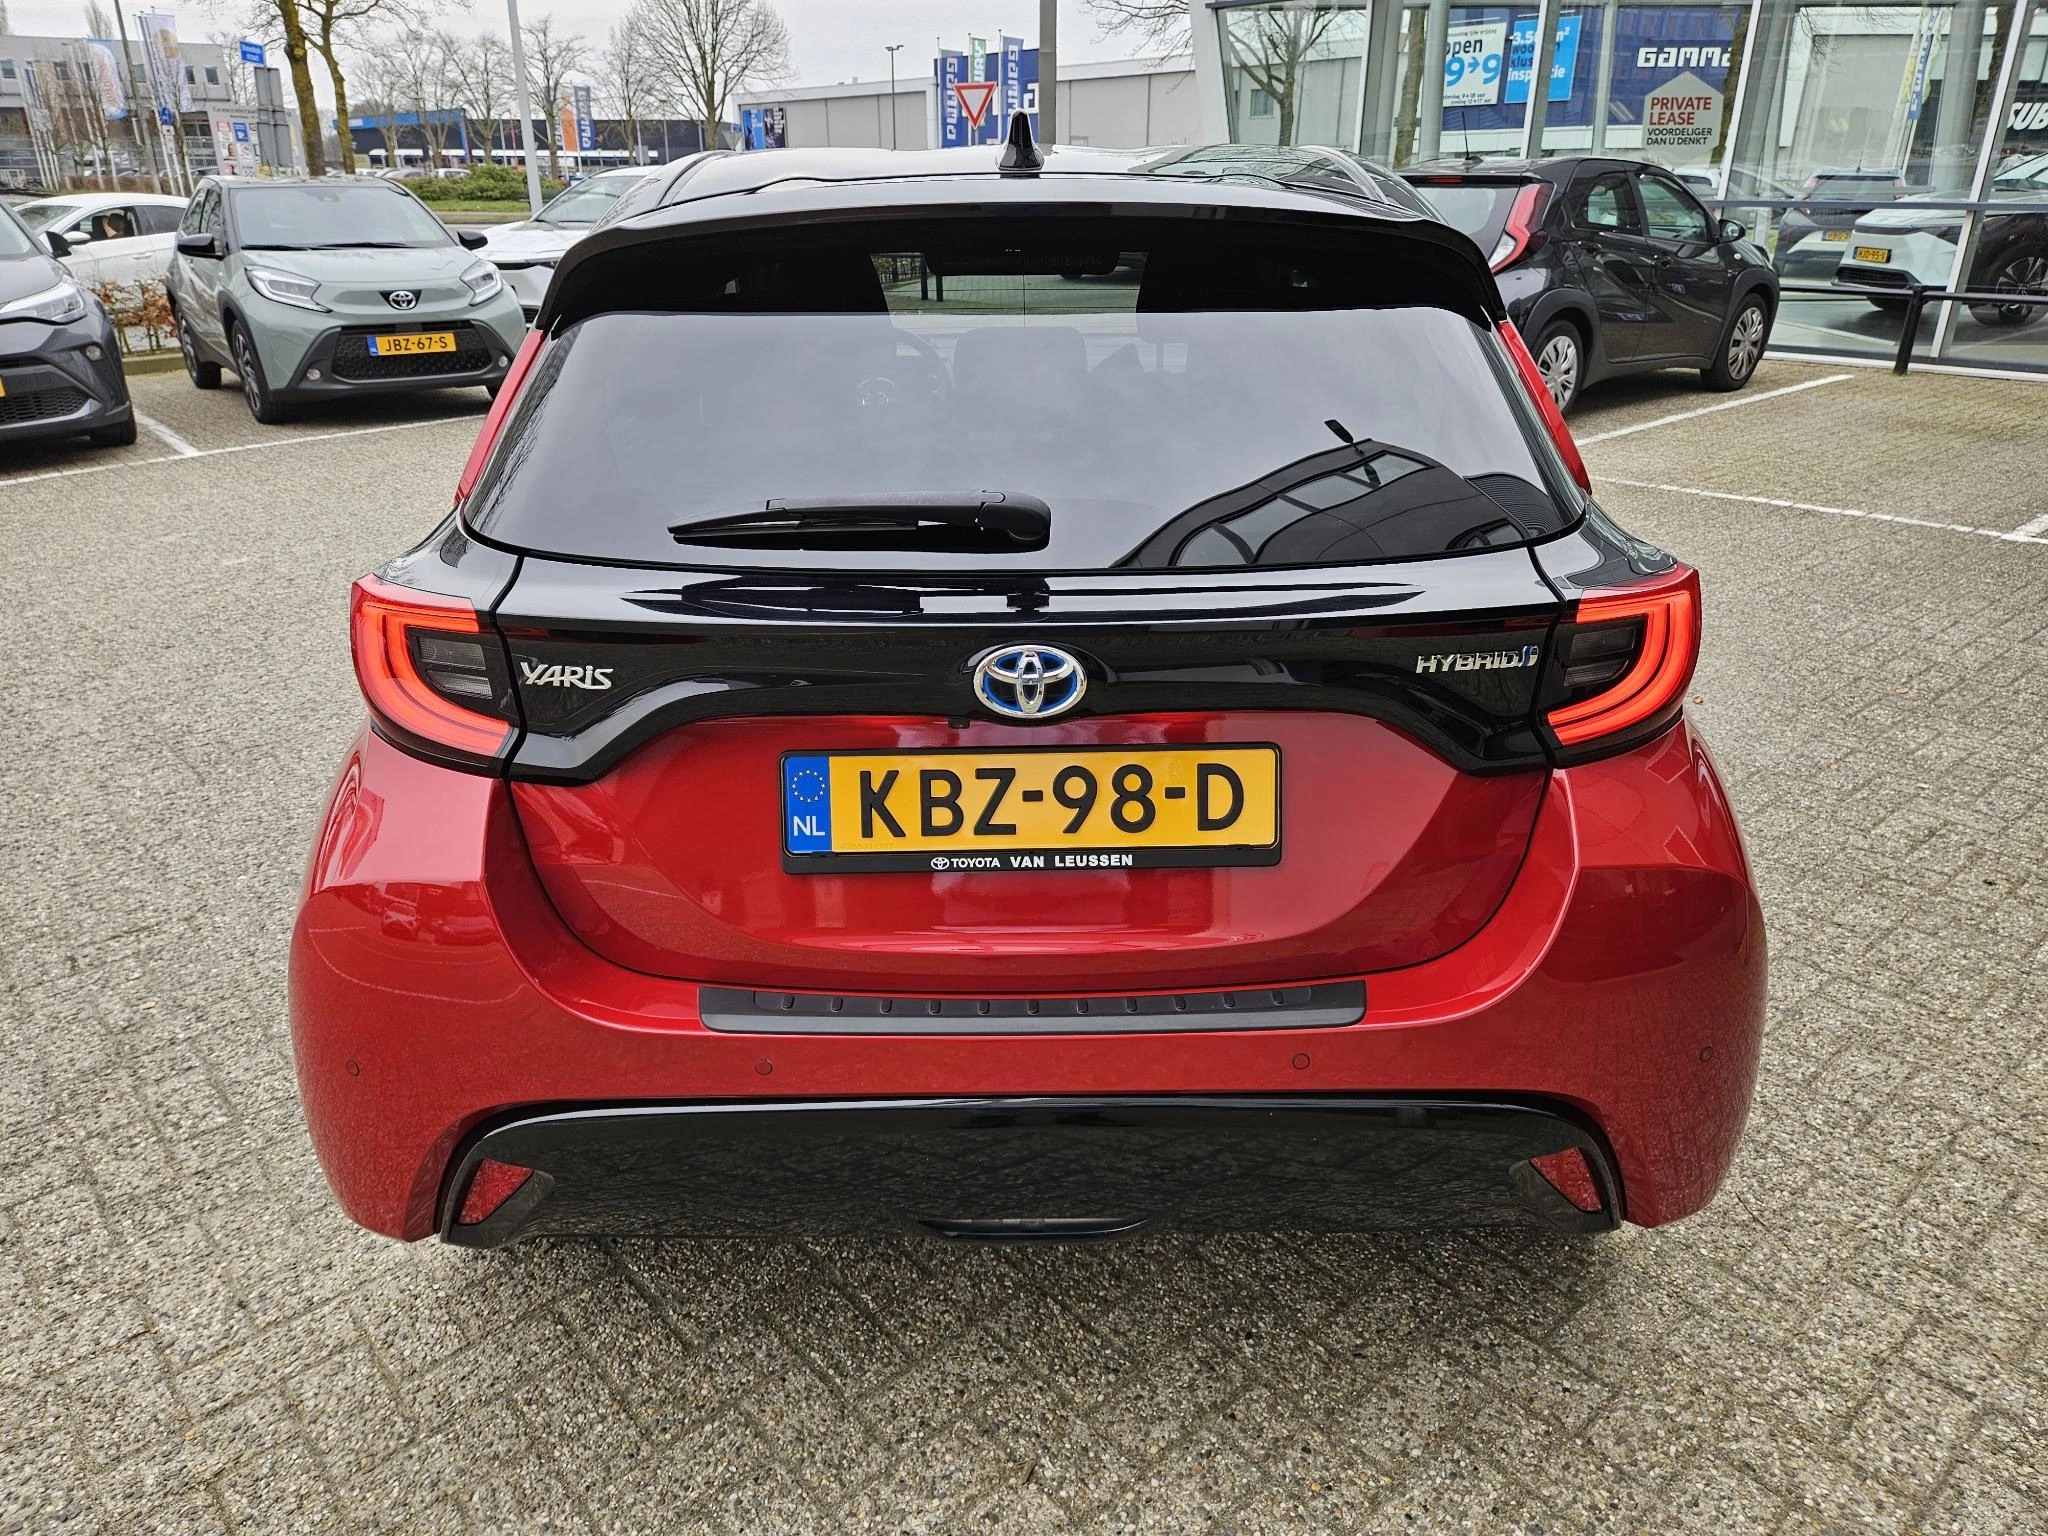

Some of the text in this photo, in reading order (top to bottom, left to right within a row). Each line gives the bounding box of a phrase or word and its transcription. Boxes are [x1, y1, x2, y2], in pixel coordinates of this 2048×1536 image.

[1445, 53, 1503, 87] 9 9
[1651, 97, 1712, 111] PRIVATE
[1649, 112, 1695, 126] LEASE
[1647, 127, 1713, 136] VOORDELIGER
[1646, 137, 1708, 146] DAN U DENKT
[385, 336, 448, 352] JBZ-67-S
[1415, 650, 1521, 674] HYBRID
[520, 661, 614, 690] YARIS
[859, 763, 1245, 839] KBZ-98-D
[793, 815, 826, 837] NL
[951, 854, 1133, 868] TOYOTA VAN LEUSSEN
